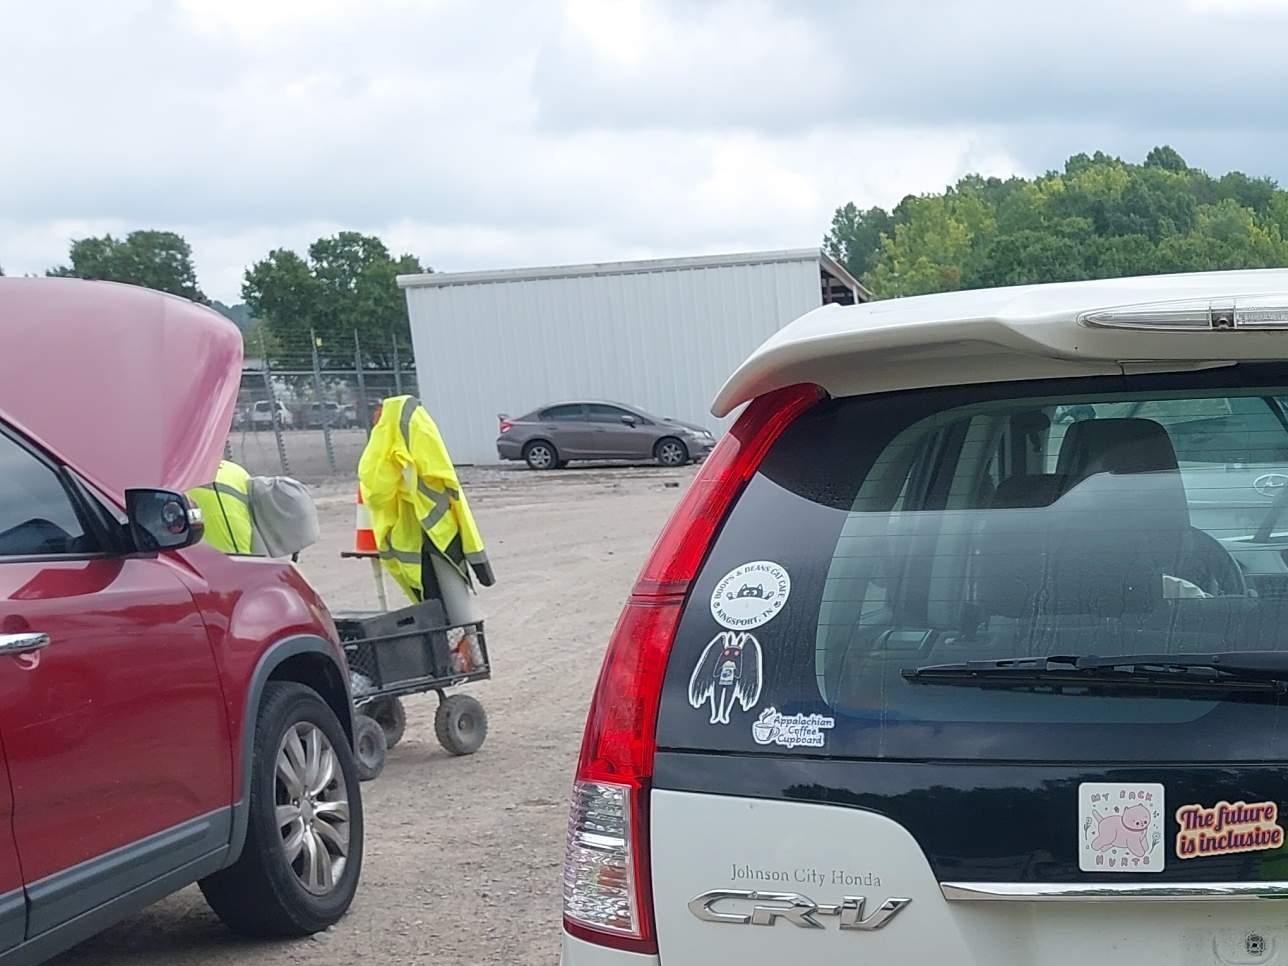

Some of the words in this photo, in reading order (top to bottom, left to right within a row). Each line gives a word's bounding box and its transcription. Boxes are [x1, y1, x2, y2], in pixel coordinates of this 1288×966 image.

[762, 608, 774, 618] TN
[773, 716, 832, 728] Appalachian
[788, 726, 817, 737] Coffee
[777, 735, 822, 747] Cupboard
[1091, 792, 1110, 802] MY
[1119, 789, 1153, 802] BACK
[1180, 804, 1216, 830] The
[1214, 803, 1273, 832] future
[1180, 835, 1196, 854] is
[1199, 826, 1281, 852] inclusive
[1095, 856, 1150, 867] HURTS
[731, 864, 789, 881] Johnson
[794, 869, 826, 887] City
[831, 870, 882, 887] Honda
[687, 888, 913, 931] CR-V
